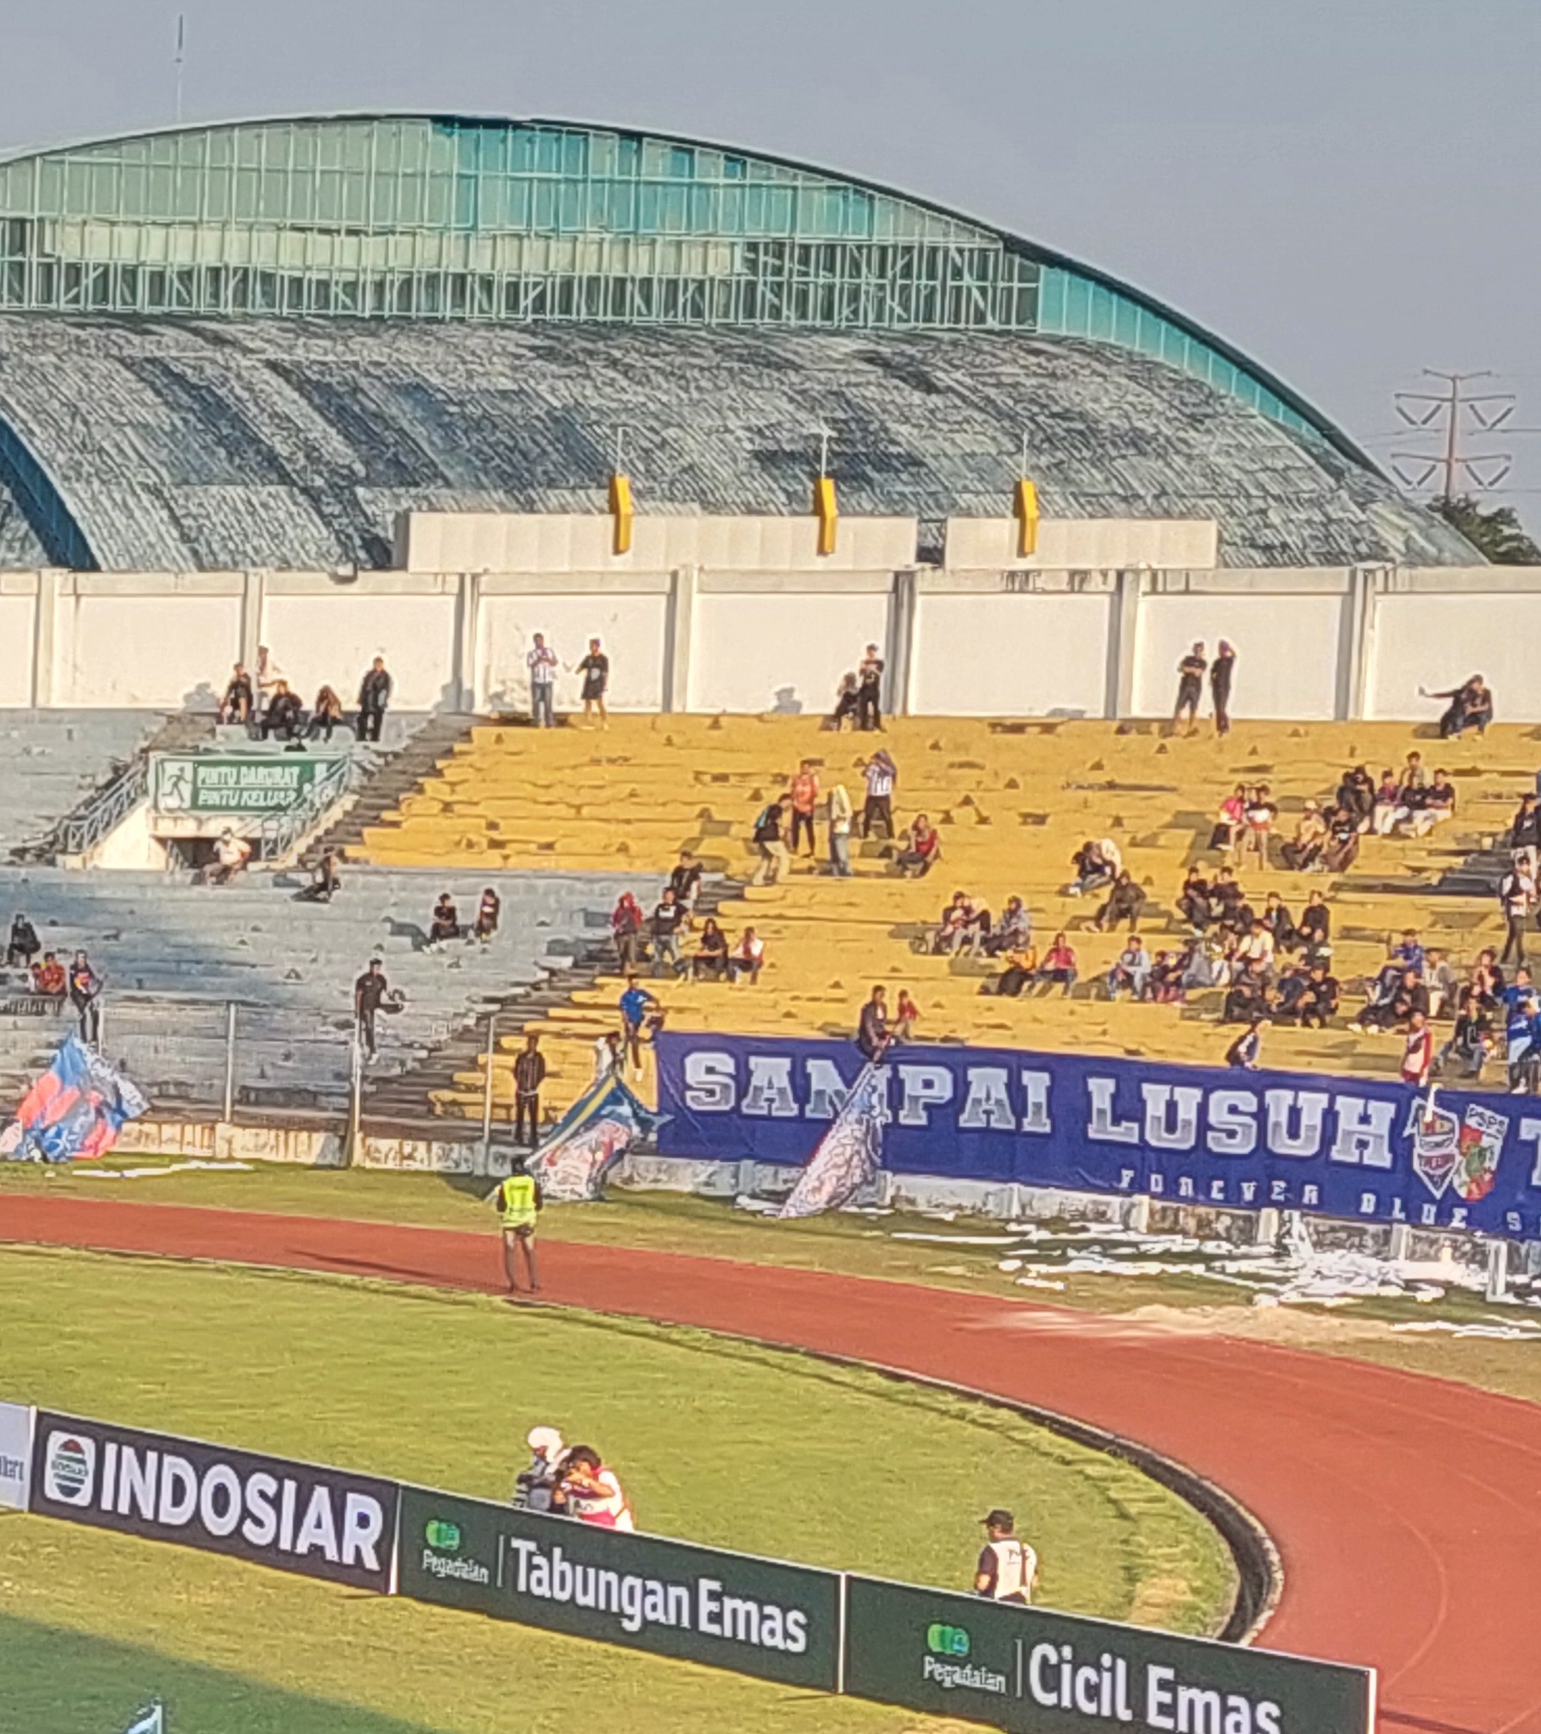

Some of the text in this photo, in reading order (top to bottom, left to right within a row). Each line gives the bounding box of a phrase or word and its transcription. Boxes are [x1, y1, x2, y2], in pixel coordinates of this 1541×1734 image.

[683, 1051, 1396, 1169] SAMPAI LUSUH
[1360, 1192, 1467, 1229] BLUE
[101, 1441, 384, 1572] INDOSIAR
[512, 1537, 809, 1653] Tabungan Emas
[923, 1655, 1006, 1694] Pegadaian
[1029, 1643, 1133, 1722] Cicil
